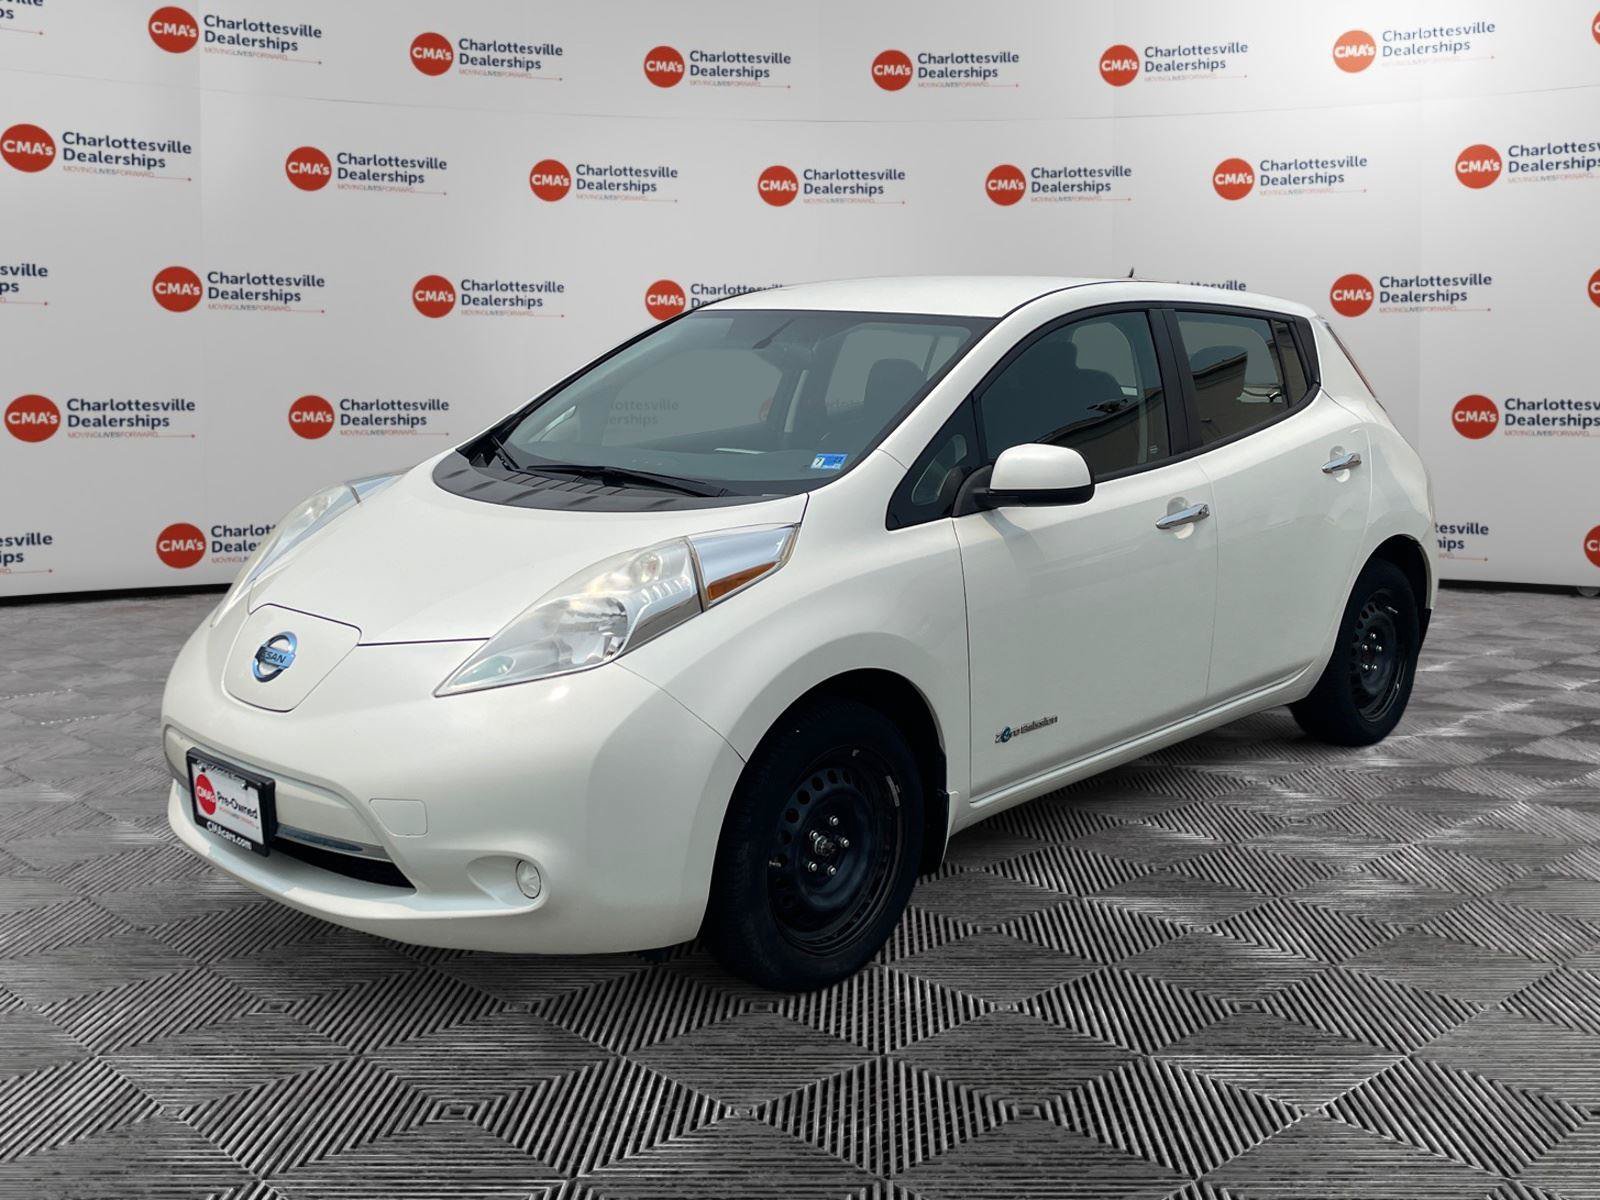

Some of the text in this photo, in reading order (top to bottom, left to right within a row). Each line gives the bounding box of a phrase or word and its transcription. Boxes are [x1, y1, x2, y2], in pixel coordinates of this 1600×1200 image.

[152, 22, 196, 37] CMA's
[203, 14, 322, 38] Charlottesville
[1382, 21, 1495, 42] Charlottesville
[204, 30, 298, 53] Dealerships
[458, 38, 563, 56] Charlottesville
[413, 47, 450, 60] CMA's
[1144, 42, 1248, 58] Charlottesville
[1335, 43, 1374, 59] CMA's
[1382, 41, 1471, 57] Dealerships
[458, 52, 542, 72] Dealerships
[689, 50, 792, 64] Charlottesville
[917, 52, 1020, 64] Charlottesville
[646, 60, 683, 73] CMA's
[874, 64, 911, 76] CMA's
[1101, 58, 1138, 71] CMA's
[1144, 59, 1226, 73] Dealerships
[690, 64, 770, 80] Dealerships
[918, 66, 998, 80] Dealerships
[3, 140, 53, 156] CMA's
[62, 131, 192, 154] Charlottesville
[62, 148, 166, 170] Dealerships
[336, 152, 448, 170] Charlottesville
[1259, 156, 1368, 172] Charlottesville
[1457, 158, 1500, 174] CMA's
[288, 161, 330, 175] CMA's
[575, 164, 678, 178] Charlottesville
[803, 168, 906, 180] Charlottesville
[1030, 166, 1132, 179] Charlottesville
[337, 167, 425, 186] Dealerships
[532, 174, 570, 187] CMA's
[1215, 172, 1254, 186] CMA's
[1260, 172, 1345, 186] Dealerships
[576, 178, 657, 194] Dealerships
[760, 179, 796, 192] CMA's
[803, 183, 884, 197] Dealerships
[988, 179, 1024, 191] CMA's
[1031, 180, 1112, 194] Dealerships
[206, 271, 325, 287] Charlottesville
[460, 279, 565, 293] Charlottesville
[1379, 273, 1492, 288] Charlottesville
[155, 282, 200, 296] CMA's
[208, 286, 302, 305] Dealerships
[1332, 289, 1372, 302] CMA's
[415, 290, 454, 303] CMA's
[460, 294, 544, 310] Dealerships
[647, 294, 684, 306] CMA's
[1379, 289, 1468, 304] Dealerships
[66, 398, 196, 412] Charlottesville
[339, 398, 450, 412] Charlottesville
[8, 411, 57, 426] CMA's
[67, 414, 170, 430] Dealerships
[291, 410, 332, 424] CMA's
[340, 413, 428, 428] Dealerships
[1454, 410, 1496, 423] CMA's
[1504, 413, 1600, 430] Dealerships
[159, 539, 204, 552] CMA's
[217, 791, 258, 819] Pre-Owned
